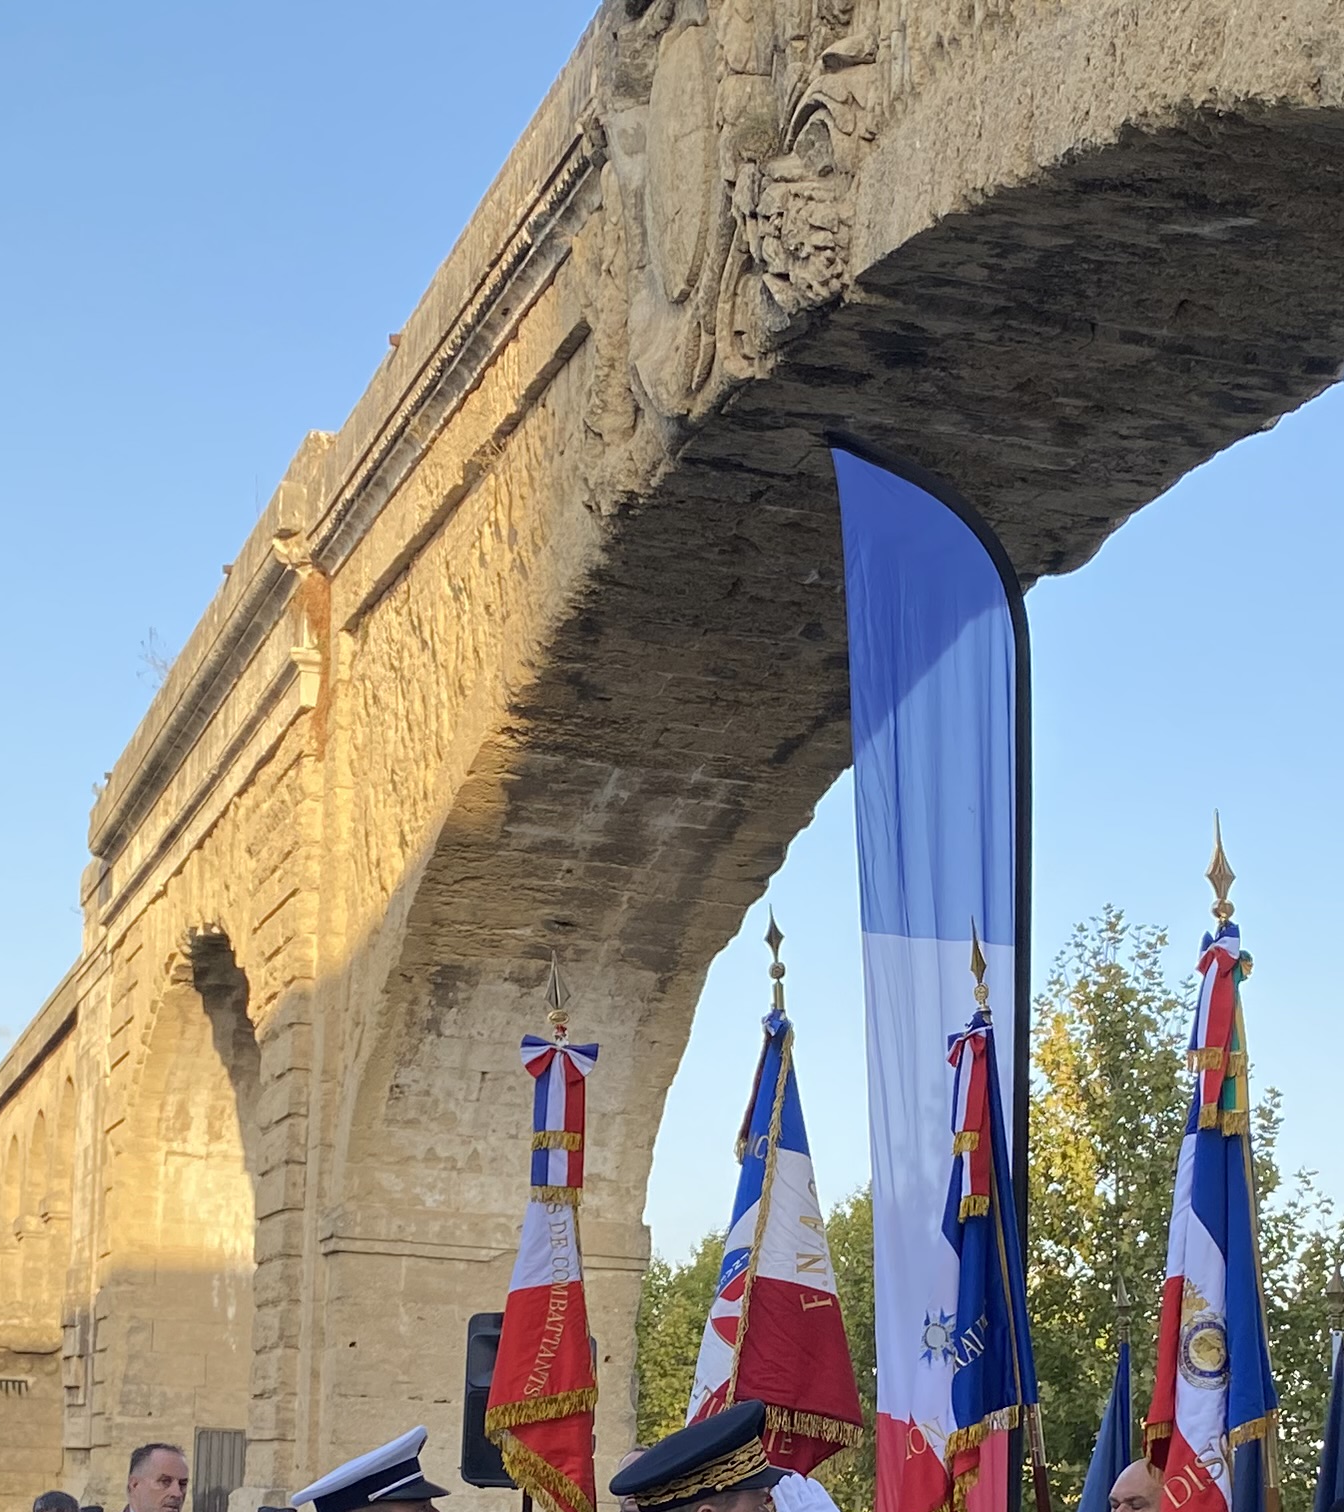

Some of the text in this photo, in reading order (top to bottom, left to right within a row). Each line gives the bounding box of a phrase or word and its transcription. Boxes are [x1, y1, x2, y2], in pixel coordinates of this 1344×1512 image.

[548, 1221, 568, 1249] DE
[523, 1257, 570, 1397] COMBATTANTS
[1163, 1438, 1226, 1510] DIS
